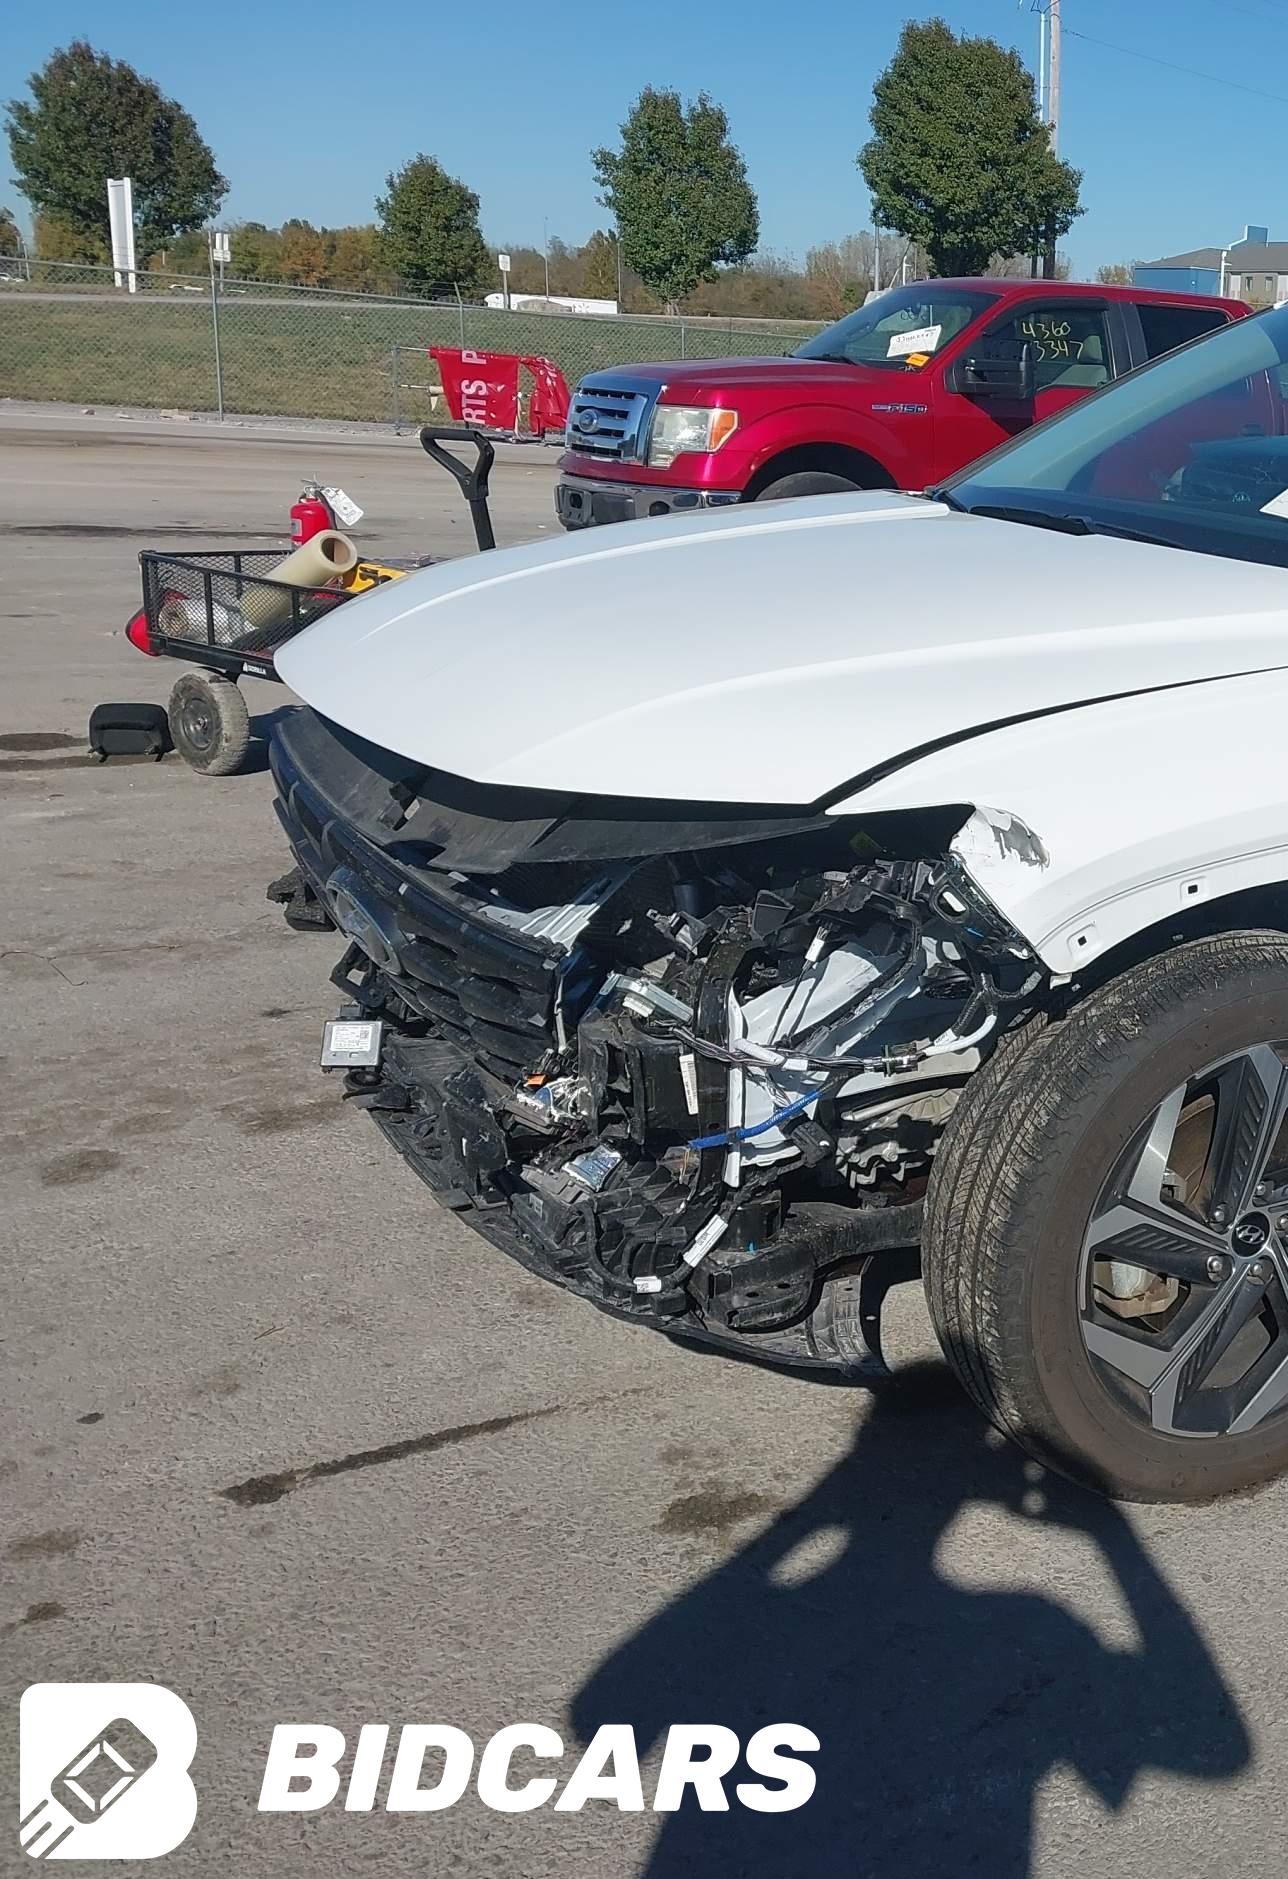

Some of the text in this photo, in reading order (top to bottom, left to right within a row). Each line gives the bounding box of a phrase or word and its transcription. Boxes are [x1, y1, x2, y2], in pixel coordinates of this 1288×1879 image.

[1022, 320, 1071, 339] 4360
[461, 350, 487, 364] P
[1033, 340, 1083, 362] 3347
